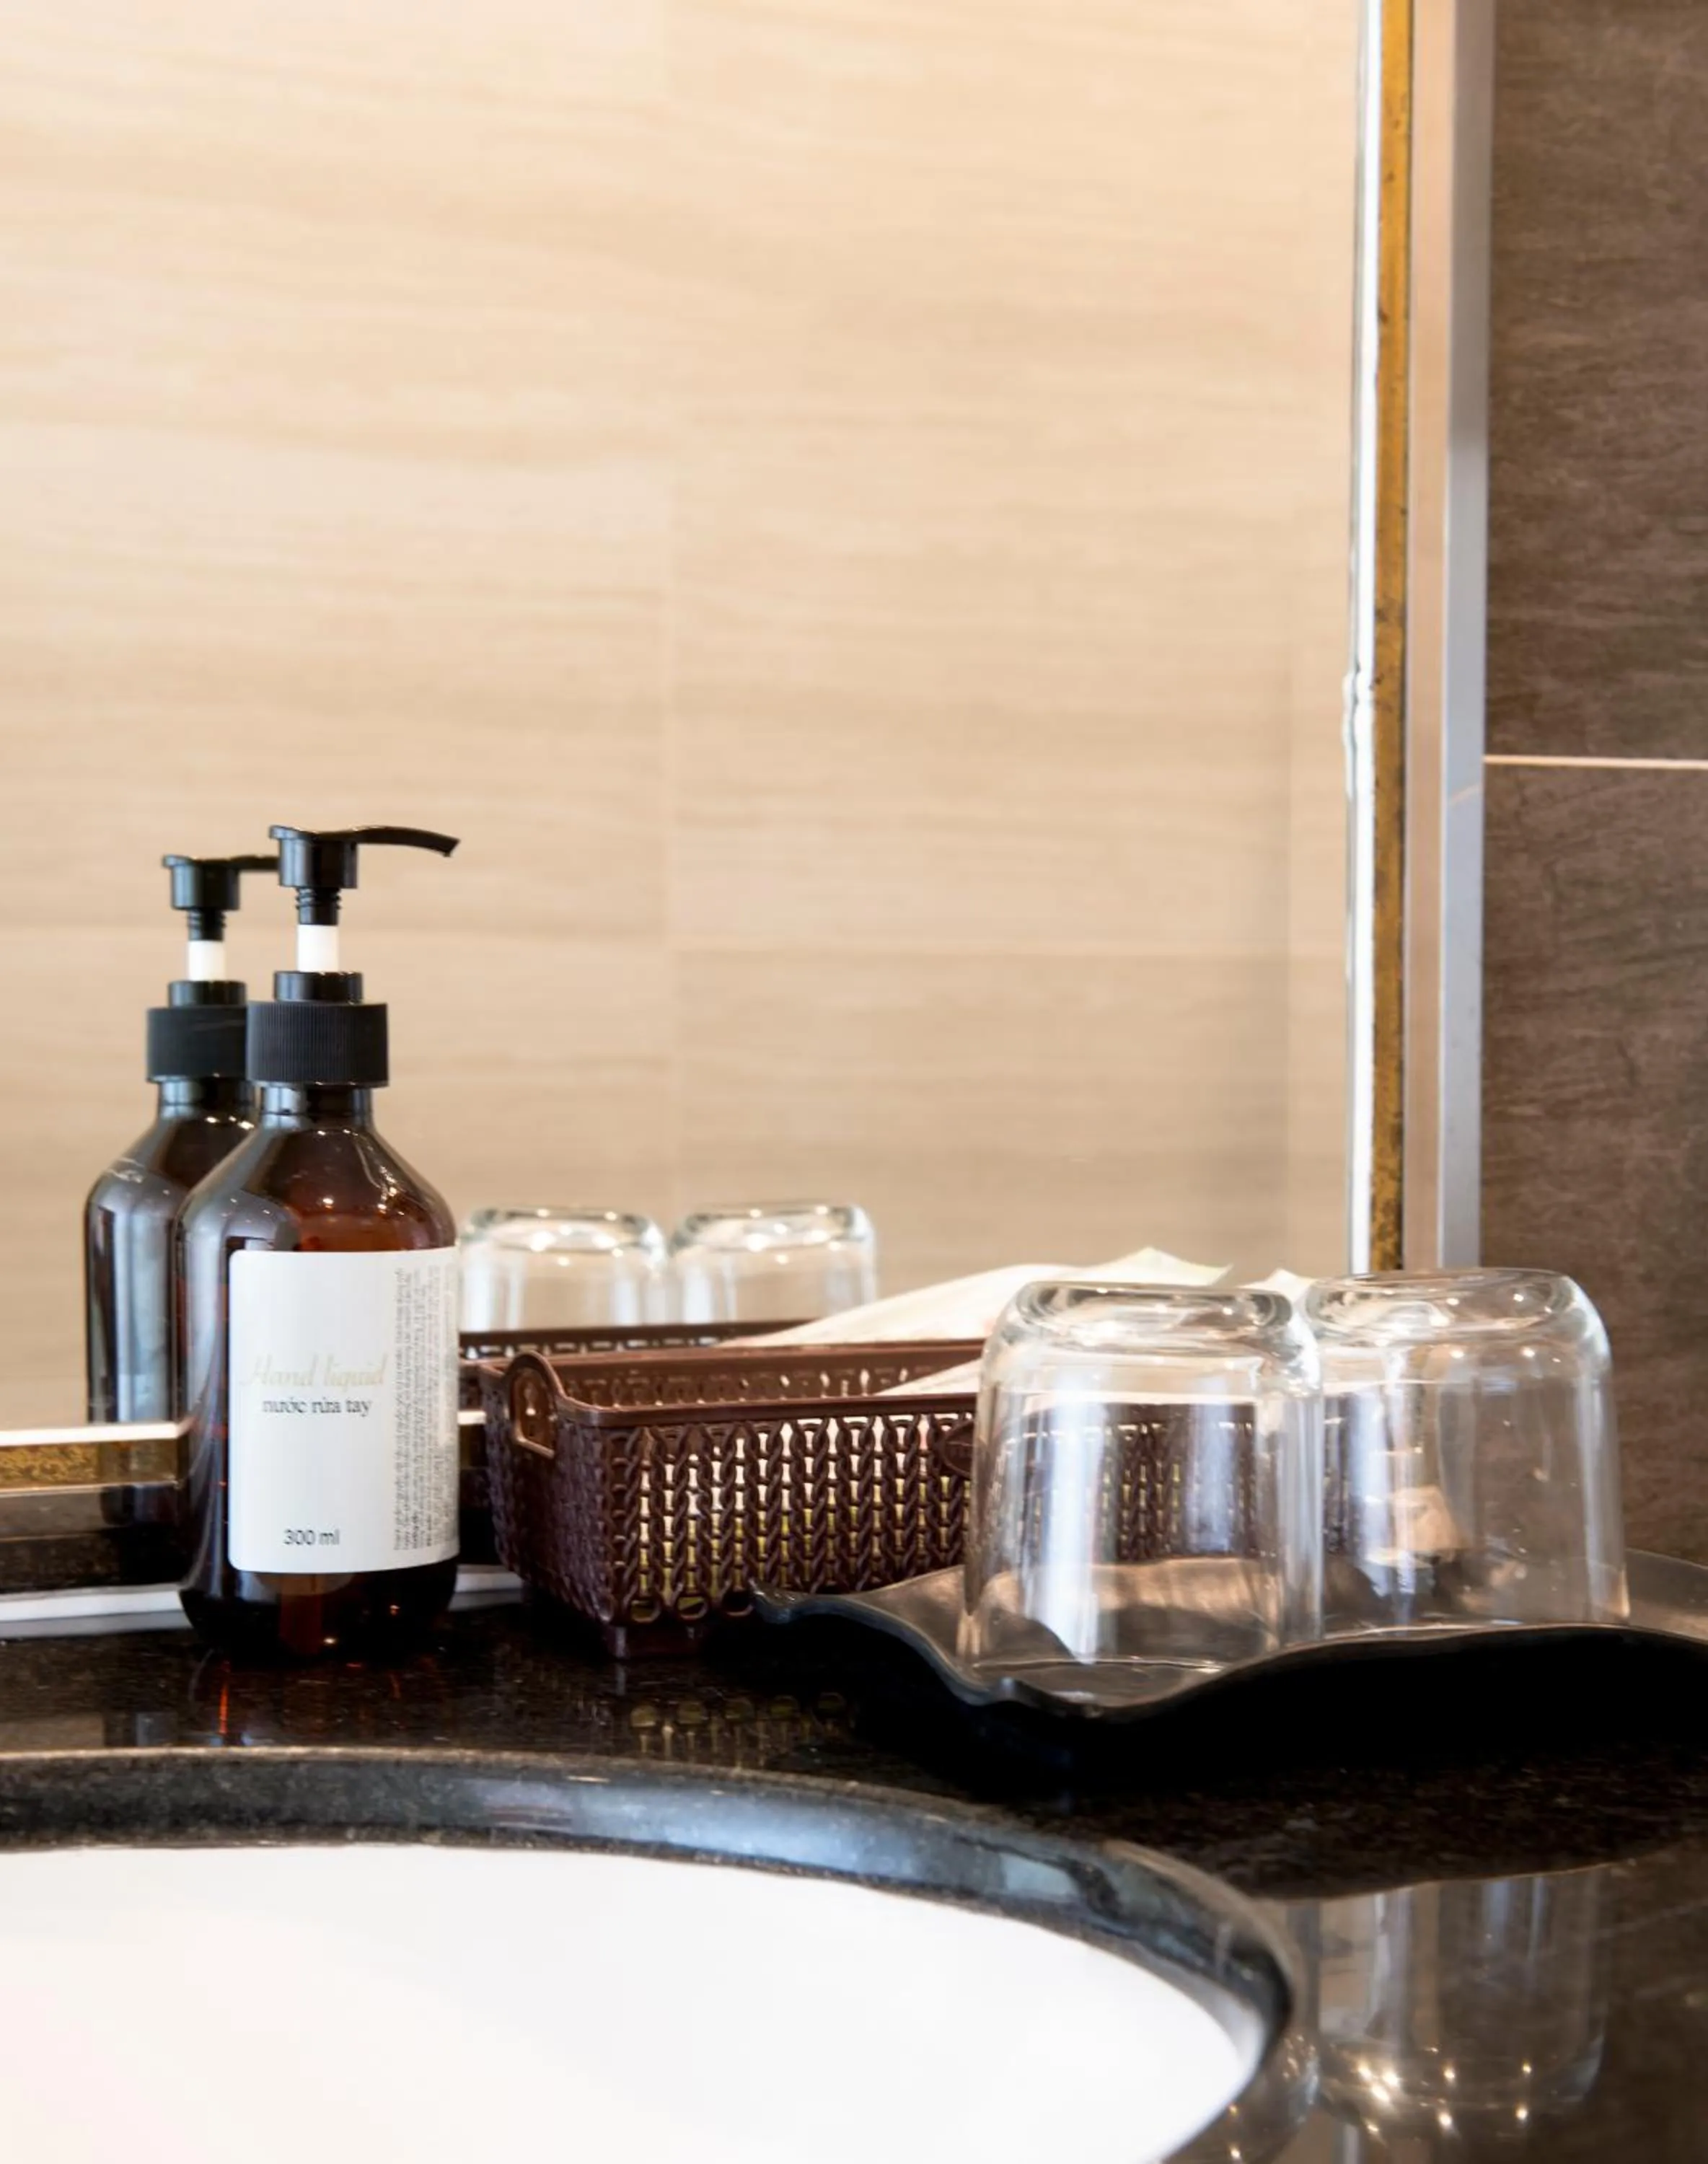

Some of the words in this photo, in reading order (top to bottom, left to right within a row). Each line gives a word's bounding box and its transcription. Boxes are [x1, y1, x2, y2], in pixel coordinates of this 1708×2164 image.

[240, 1352, 319, 1387] Hand
[324, 1353, 388, 1393] liquid
[345, 1399, 372, 1417] tay
[283, 1528, 316, 1546] 300
[319, 1528, 340, 1546] ml
